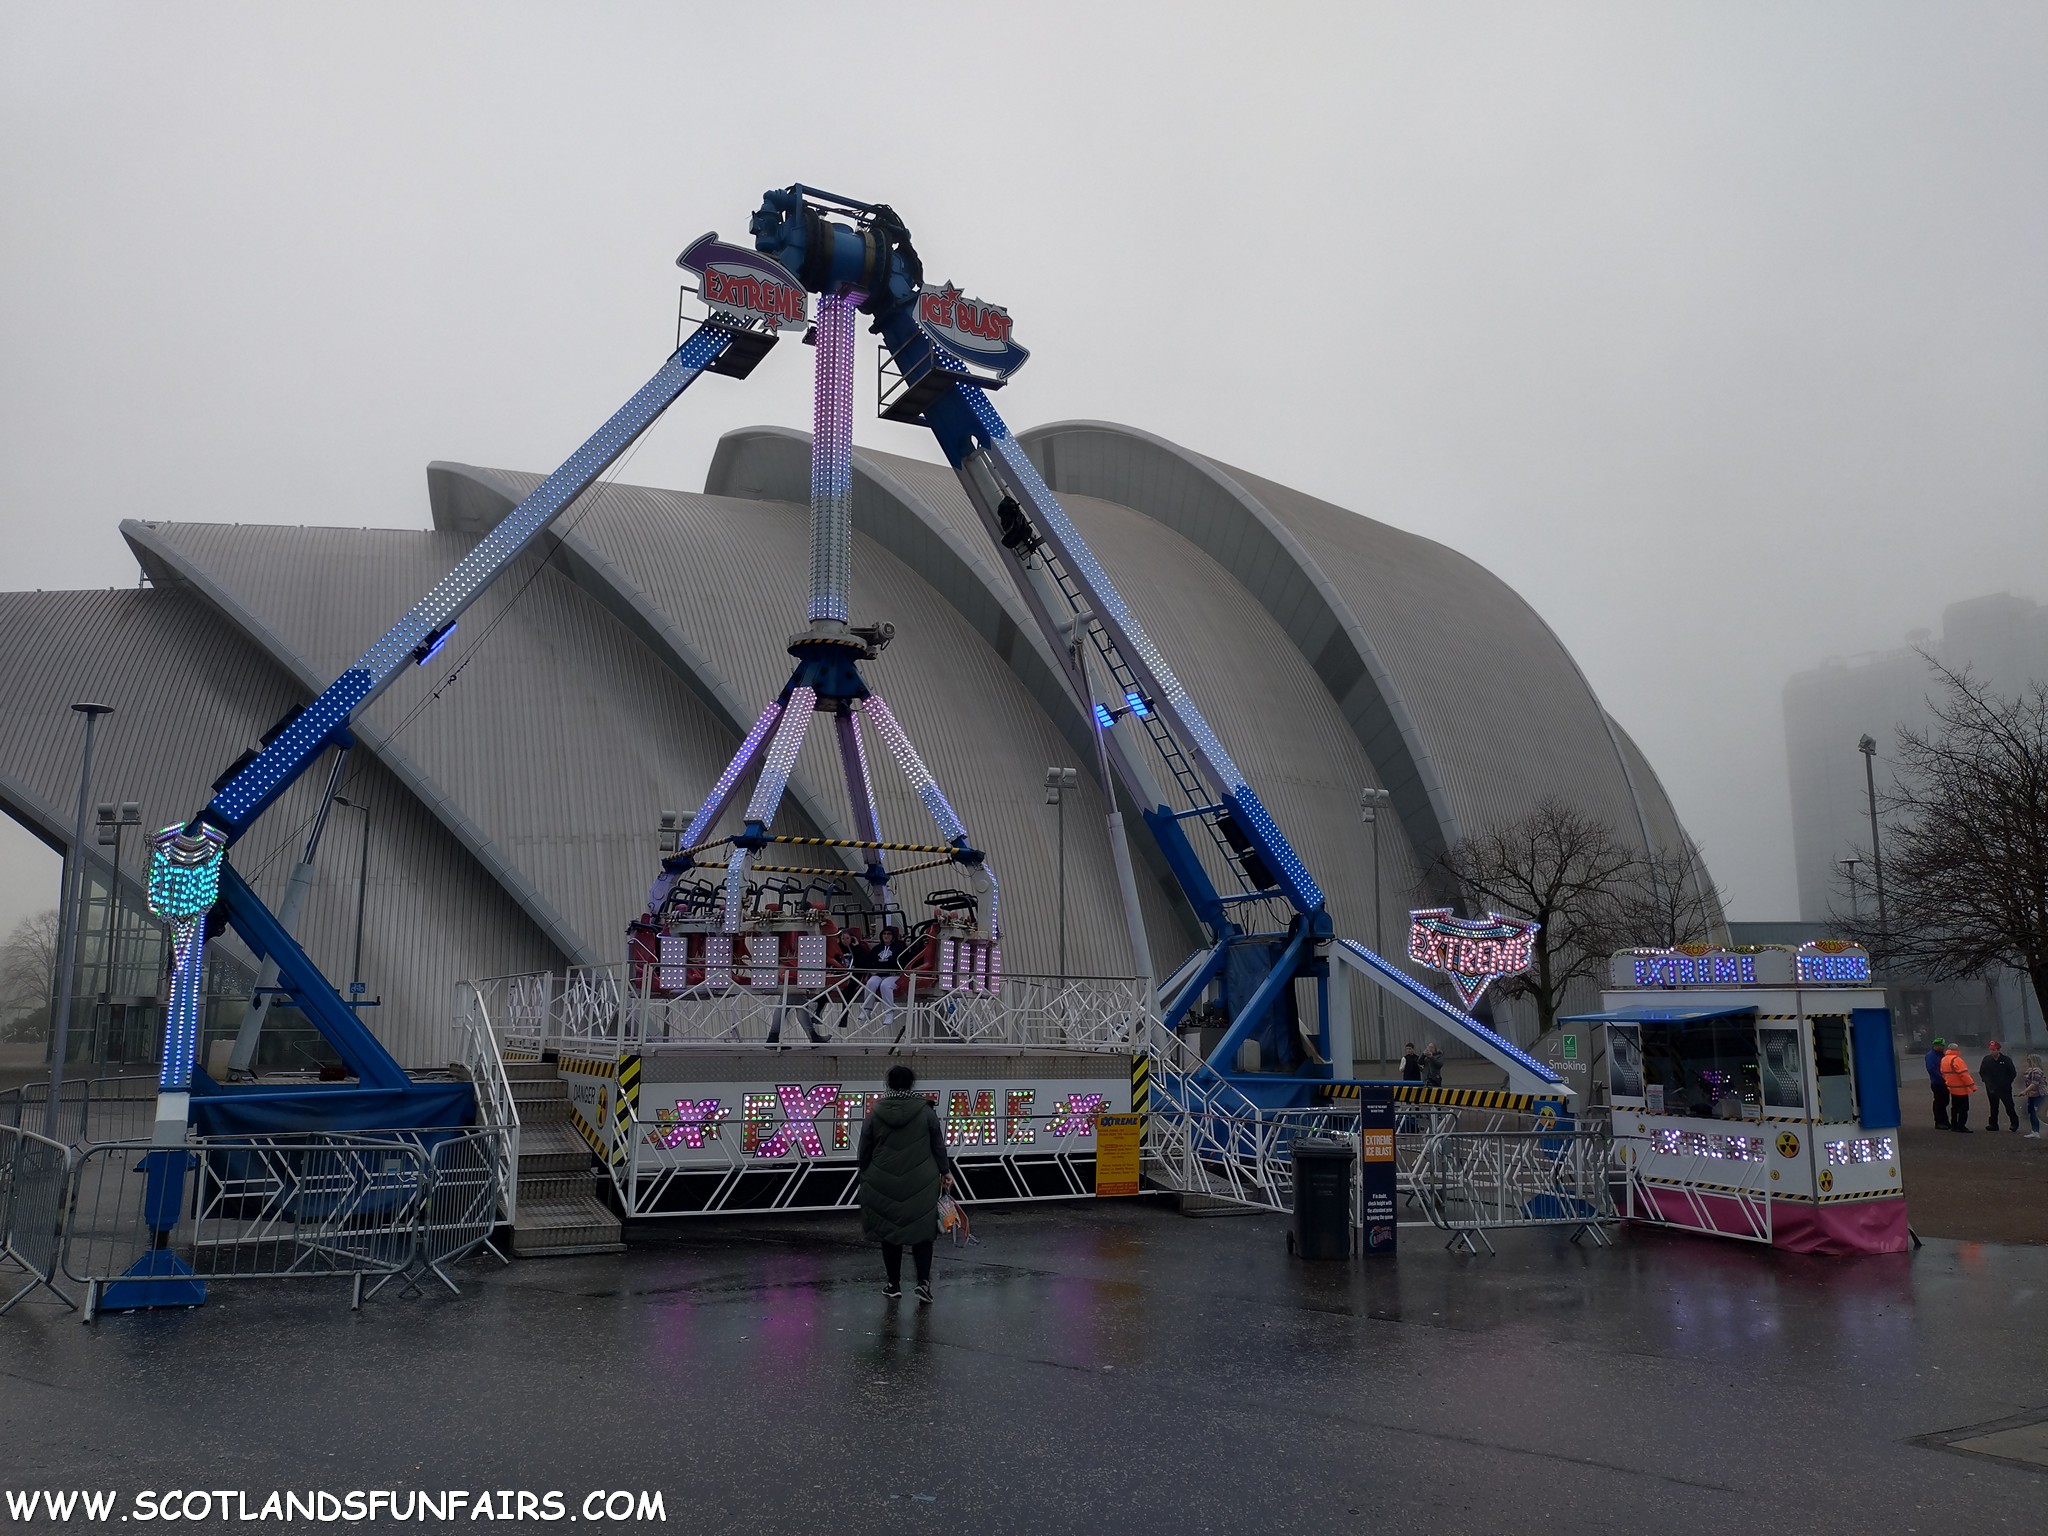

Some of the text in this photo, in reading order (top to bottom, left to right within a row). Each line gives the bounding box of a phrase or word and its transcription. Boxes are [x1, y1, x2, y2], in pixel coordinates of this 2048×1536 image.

[704, 267, 806, 321] EXTREME
[921, 292, 1014, 342] ICE BLAST
[1410, 922, 1532, 974] EXTREME
[1635, 956, 1757, 985] EXTREME
[1801, 956, 1868, 981] TOKENS
[1548, 1059, 1587, 1074] Smoking
[573, 1084, 596, 1105] DANGER
[739, 1084, 1037, 1158] EXTME
[1101, 1117, 1138, 1127] EXTREME
[1365, 1135, 1393, 1146] EXTREME
[1366, 1146, 1392, 1157] ICE BLAST
[1650, 1128, 1764, 1163] EXTREME
[1824, 1136, 1893, 1167] TOKENS
